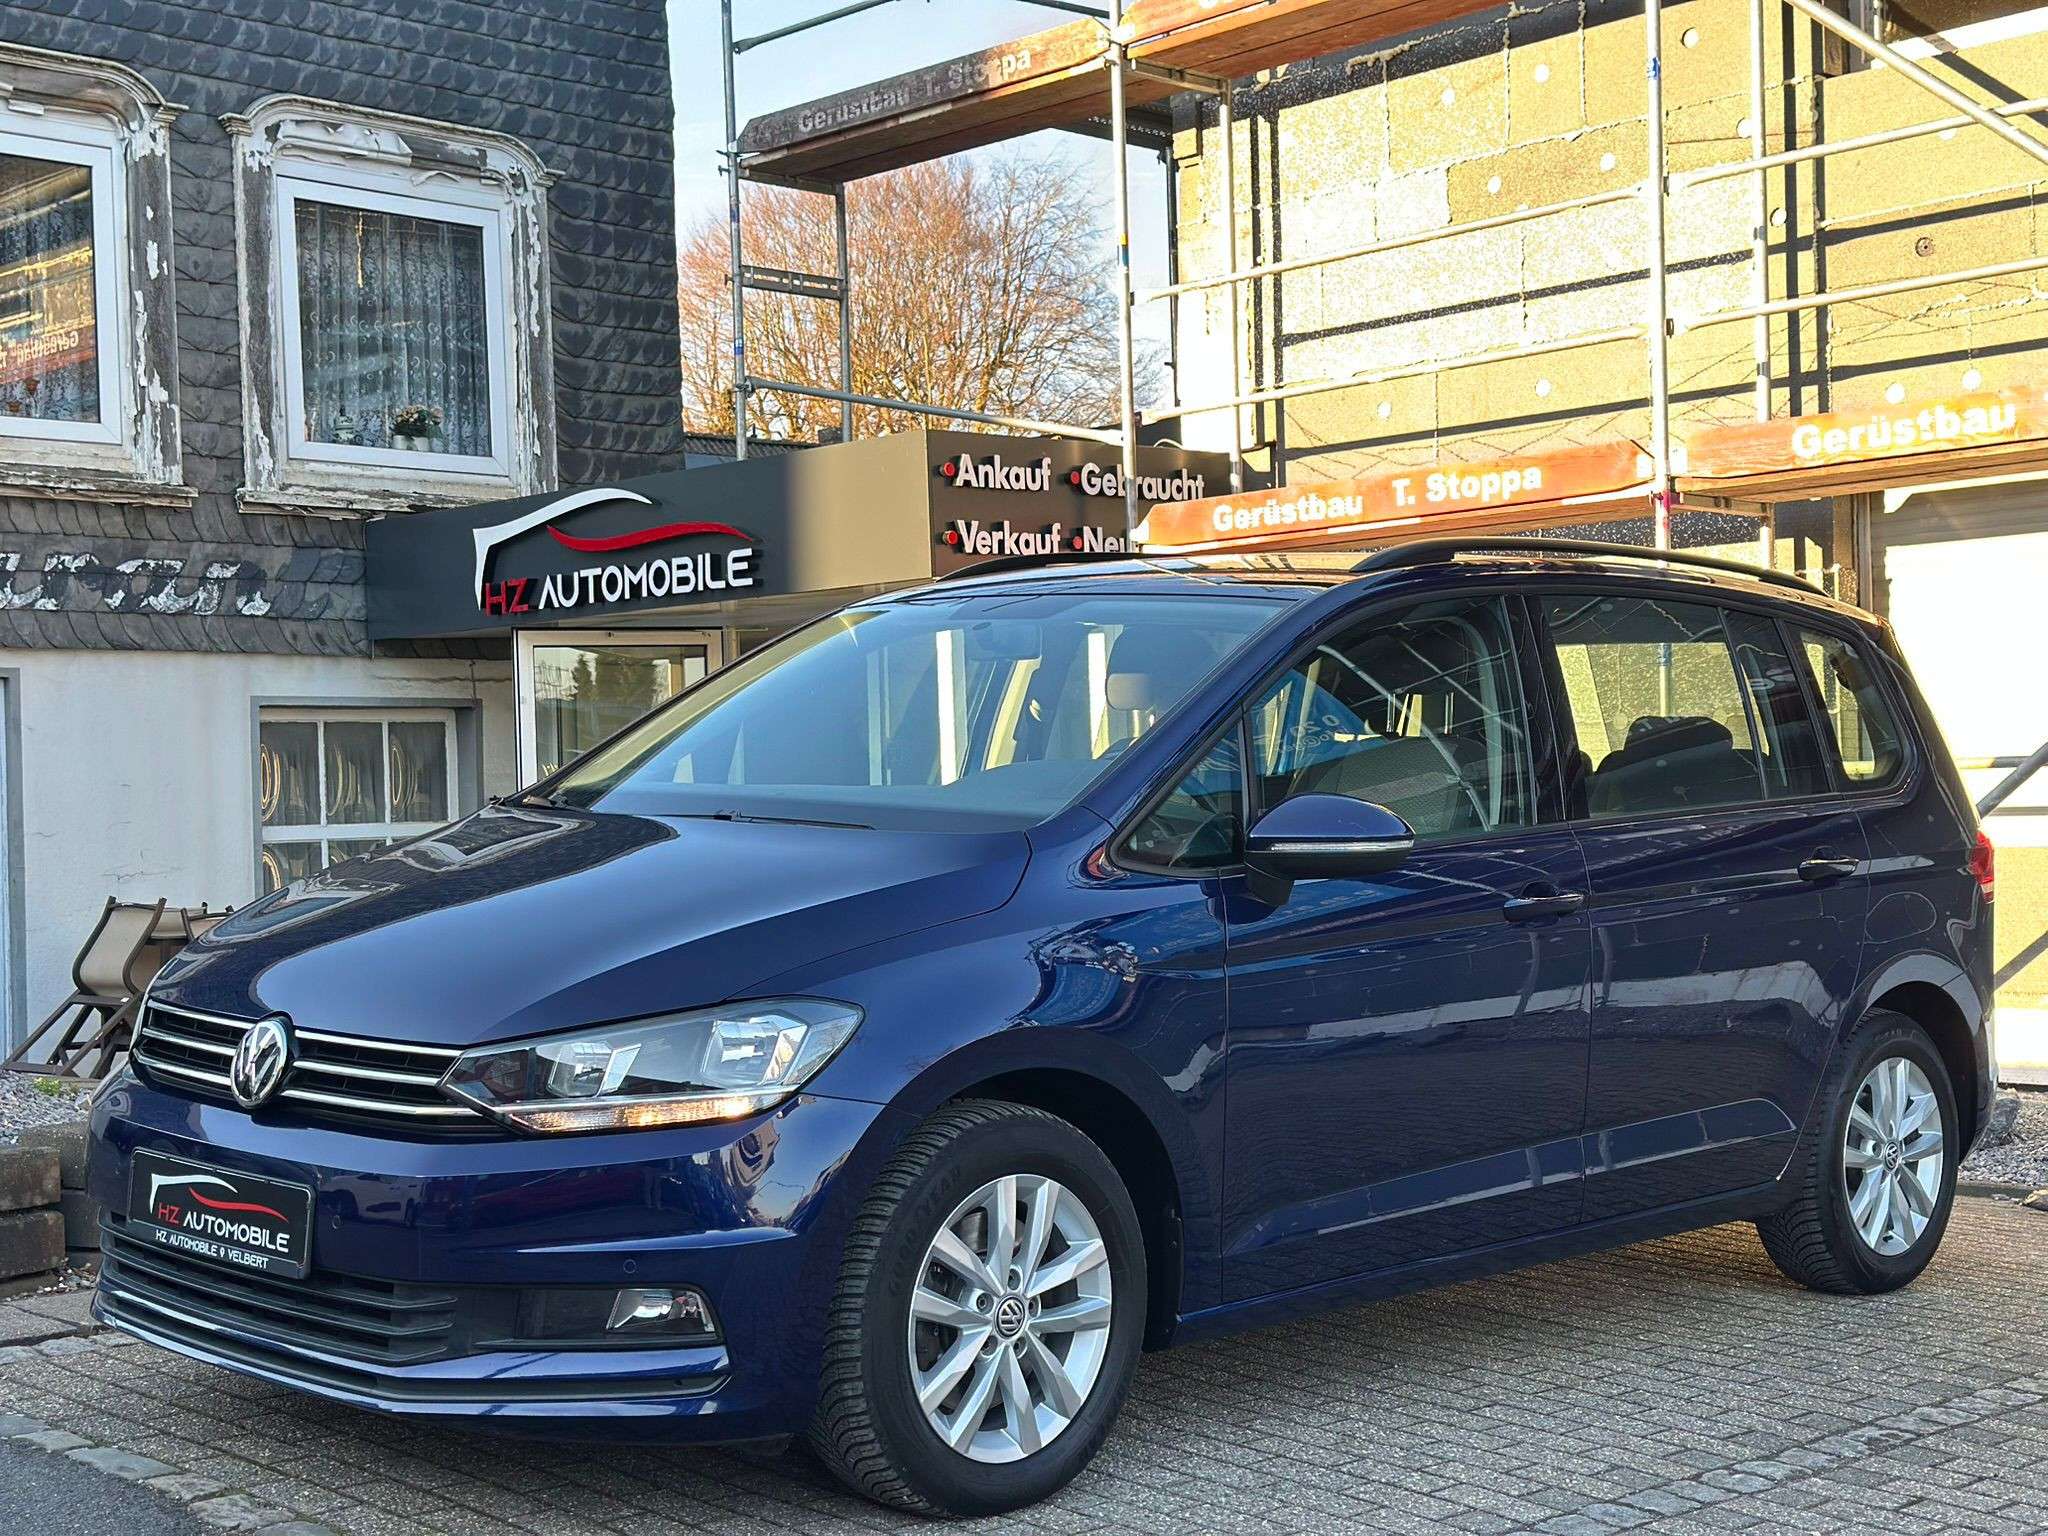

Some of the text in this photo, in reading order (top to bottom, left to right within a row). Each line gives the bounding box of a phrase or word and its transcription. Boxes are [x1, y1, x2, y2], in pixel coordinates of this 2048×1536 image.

[1791, 403, 2016, 459] Gerüstbau
[954, 453, 1051, 491] Ankauf
[1212, 467, 1542, 531] Gerüstbau T. Stoppa
[957, 519, 1061, 555] Verkauf
[485, 548, 753, 616] HZ AUTOMOBILE
[155, 1229, 269, 1270] HZ AUTOMOBILE VELBERT
[158, 1202, 290, 1253] HZ AUTOMOBILE
